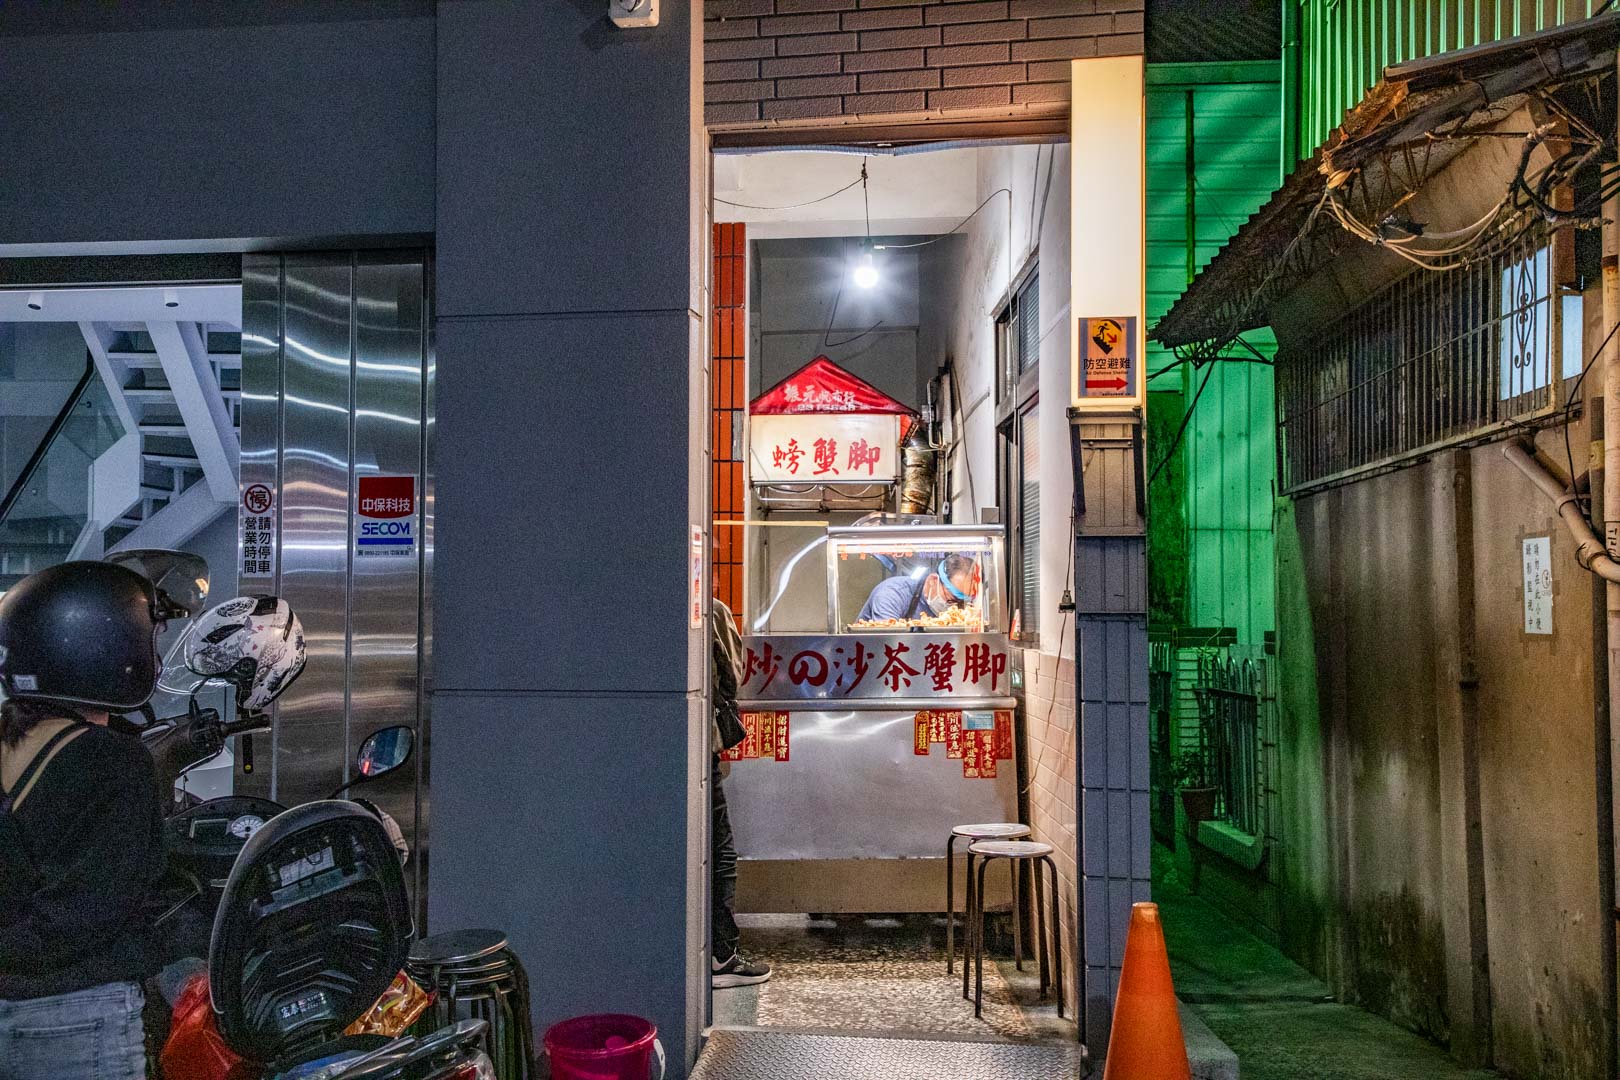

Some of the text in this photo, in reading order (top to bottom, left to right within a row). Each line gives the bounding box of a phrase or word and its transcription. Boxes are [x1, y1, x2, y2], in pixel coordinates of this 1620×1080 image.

[1083, 358, 1131, 369] 防空避難
[362, 498, 411, 513] 中保科技
[361, 522, 410, 536] SECOM
[244, 517, 257, 574] 營業時間
[258, 517, 271, 574] 請勿停車
